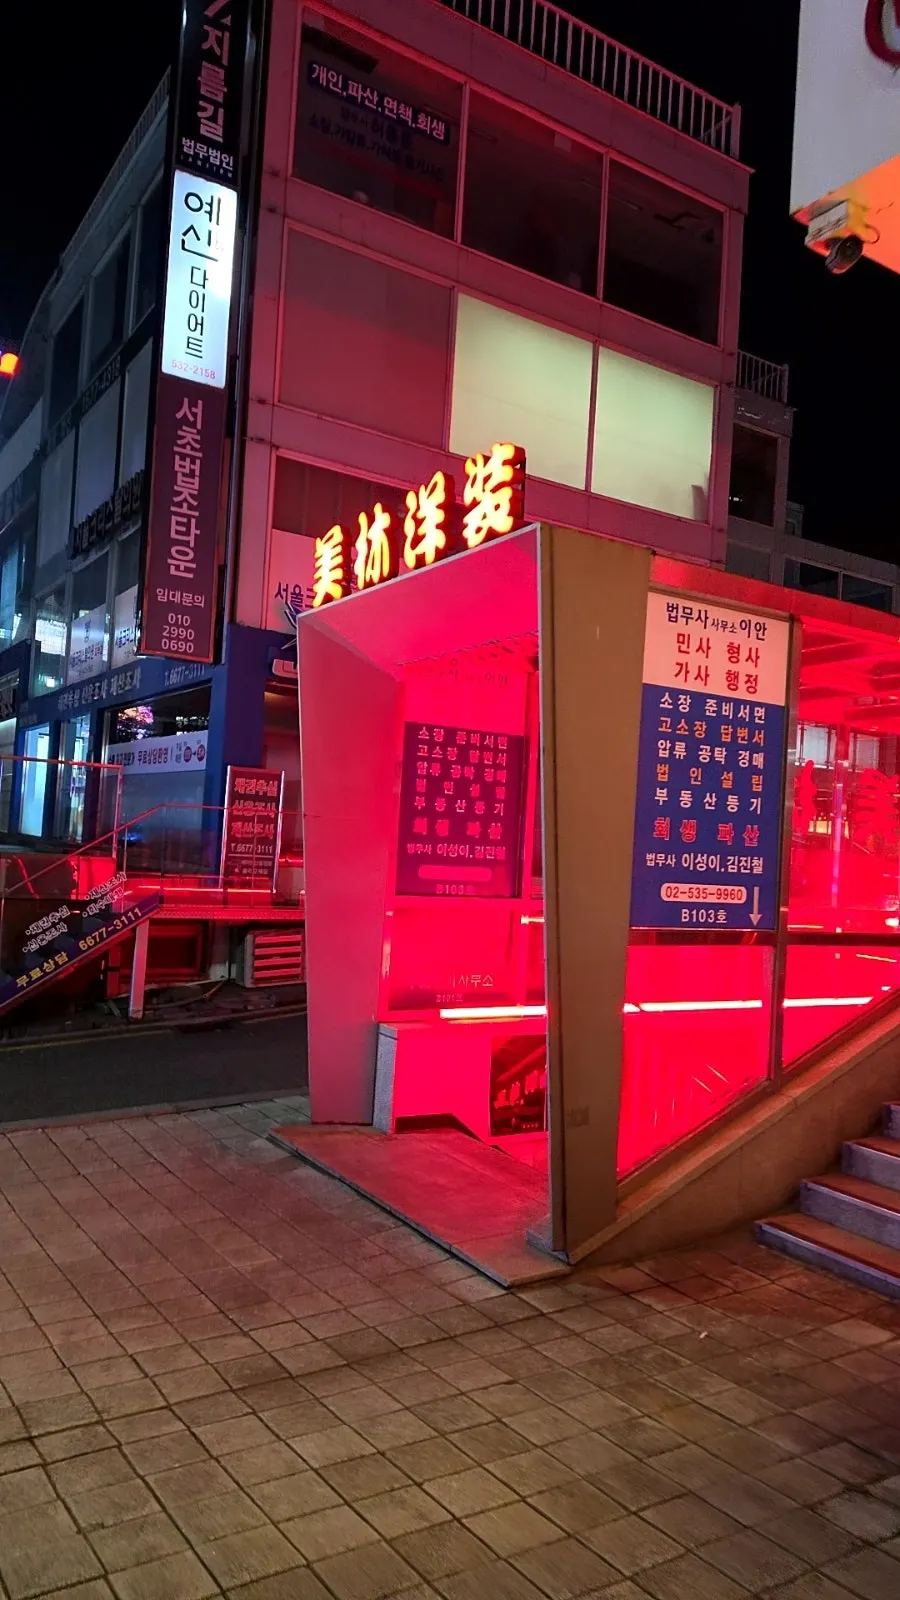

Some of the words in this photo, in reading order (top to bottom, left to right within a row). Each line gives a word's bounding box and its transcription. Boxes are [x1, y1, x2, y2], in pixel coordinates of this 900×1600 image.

[197, 25, 230, 143] 지름길
[181, 137, 234, 171] 법무법인
[181, 191, 222, 262] 예신
[185, 265, 209, 359] 다이어트
[171, 359, 216, 380] 532-2158
[167, 397, 203, 579] 서초법조타운
[156, 587, 205, 608] 임대문의
[161, 625, 195, 640] 2990
[168, 612, 191, 627] 010
[666, 602, 709, 629] 법무사
[711, 618, 738, 633] 사무소
[739, 618, 767, 641] 이안
[161, 638, 194, 653] 0690
[659, 692, 691, 713] 소장
[704, 698, 766, 724] 준비서면
[658, 717, 707, 738] 고소장
[720, 725, 765, 747] 답변서
[657, 739, 687, 760] 압류
[698, 744, 727, 765] 공탁
[737, 750, 765, 770] 경매
[646, 852, 676, 867] 법무사
[436, 884, 475, 895] B103
[665, 886, 743, 901] 02-535-9960
[681, 908, 727, 923] B103호
[16, 951, 69, 988] 무료상담
[78, 907, 142, 950] 6677-3111
